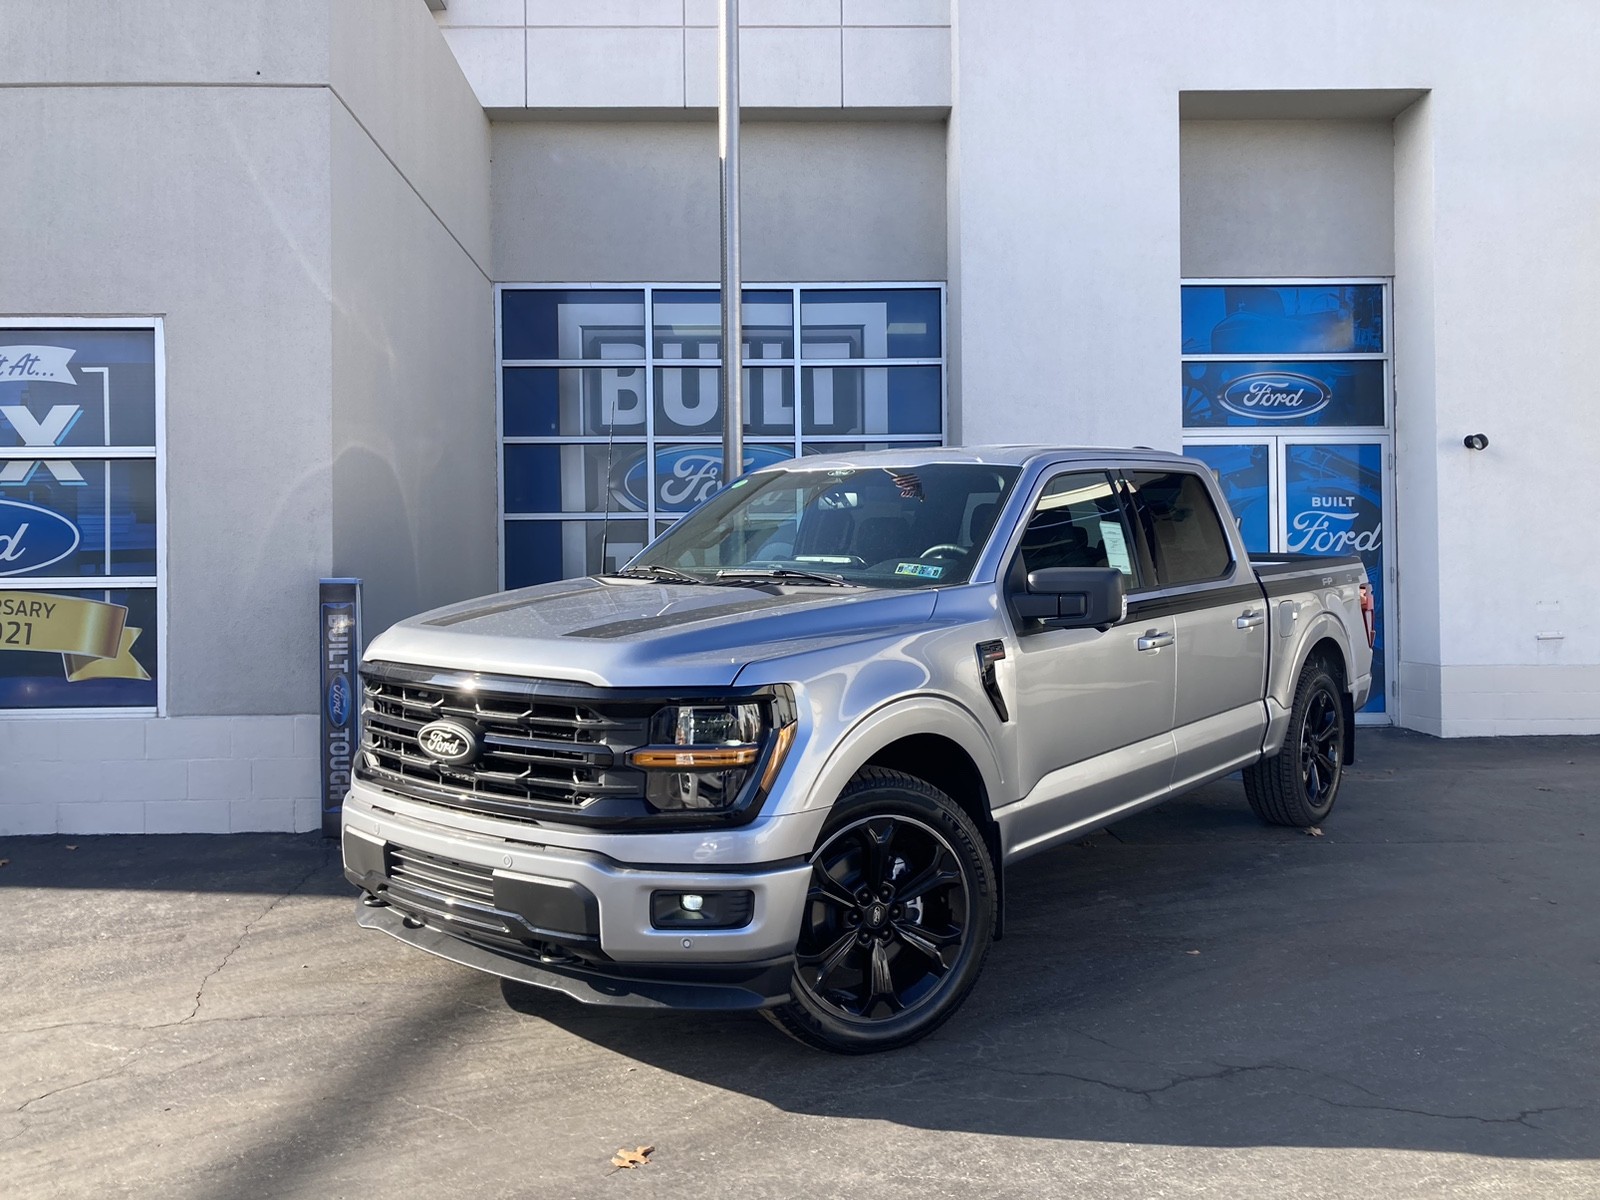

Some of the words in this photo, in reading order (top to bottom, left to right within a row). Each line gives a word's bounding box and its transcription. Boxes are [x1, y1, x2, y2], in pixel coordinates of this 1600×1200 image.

[1243, 381, 1305, 407] Ford
[1311, 496, 1355, 507] BUILT
[1287, 510, 1381, 552] Ford
[327, 614, 349, 673] BUILT
[427, 730, 460, 755] Ford
[329, 727, 350, 800] TOUGH
